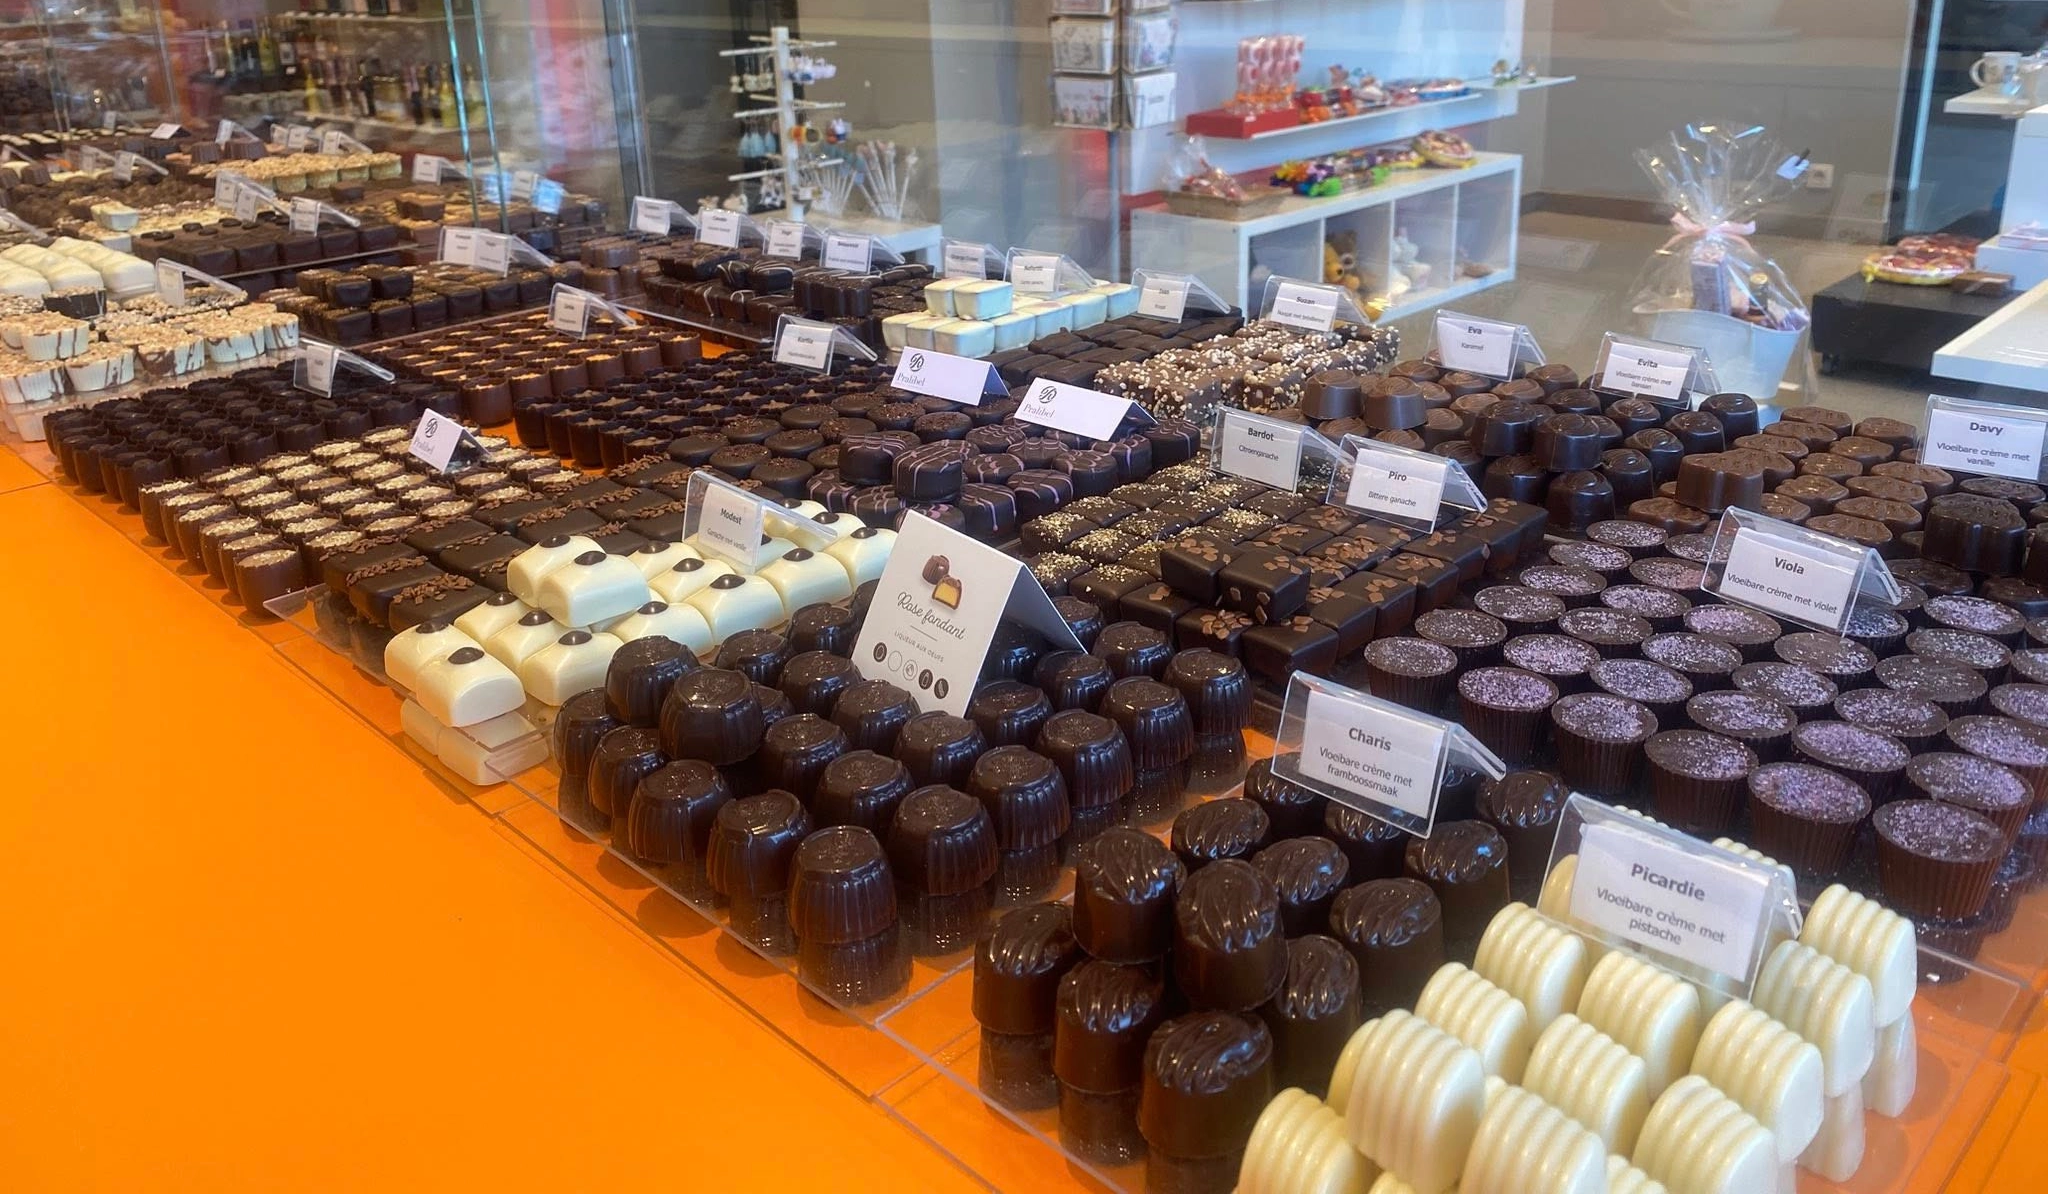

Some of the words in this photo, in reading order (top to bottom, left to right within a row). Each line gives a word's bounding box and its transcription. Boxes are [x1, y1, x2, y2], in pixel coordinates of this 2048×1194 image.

[1468, 326, 1482, 335] Eva
[1462, 342, 1484, 351] Karamel
[1637, 358, 1658, 368] Evita
[897, 372, 926, 387] Pralibel
[1616, 370, 1641, 381] Vloeibare
[1023, 404, 1055, 418] Pralibel
[1248, 427, 1274, 442] Bardot
[1969, 422, 2004, 436] Davy
[1238, 444, 1279, 462] Citroenganache
[1936, 442, 1978, 455] Vloeibare
[1980, 448, 2009, 459] crème
[2011, 453, 2030, 462] met
[1967, 456, 1996, 467] vanille
[1388, 470, 1407, 482] Piro
[1368, 490, 1389, 502] Bittere
[1390, 496, 1416, 507] ganache
[720, 508, 742, 525] Modest
[1774, 557, 1805, 575] Viola
[1727, 573, 1765, 592] Vloeibare
[1766, 585, 1792, 601] crème
[1794, 594, 1812, 608] met
[1814, 600, 1838, 614] violet
[897, 591, 923, 618] Rose
[920, 608, 967, 641] fondant
[894, 630, 916, 648] LIQUEUR
[916, 643, 927, 653] AUX
[1348, 728, 1392, 752] Charis
[1319, 746, 1361, 770] Vloeibare
[1362, 760, 1392, 782] crème
[1393, 774, 1413, 788] met
[1327, 765, 1399, 798] framboossmaak
[1631, 863, 1706, 902] Picardie
[1597, 887, 1653, 917] Vloeibare
[1656, 908, 1696, 933] crème
[1699, 925, 1726, 945] met
[1629, 918, 1682, 946] pistache
